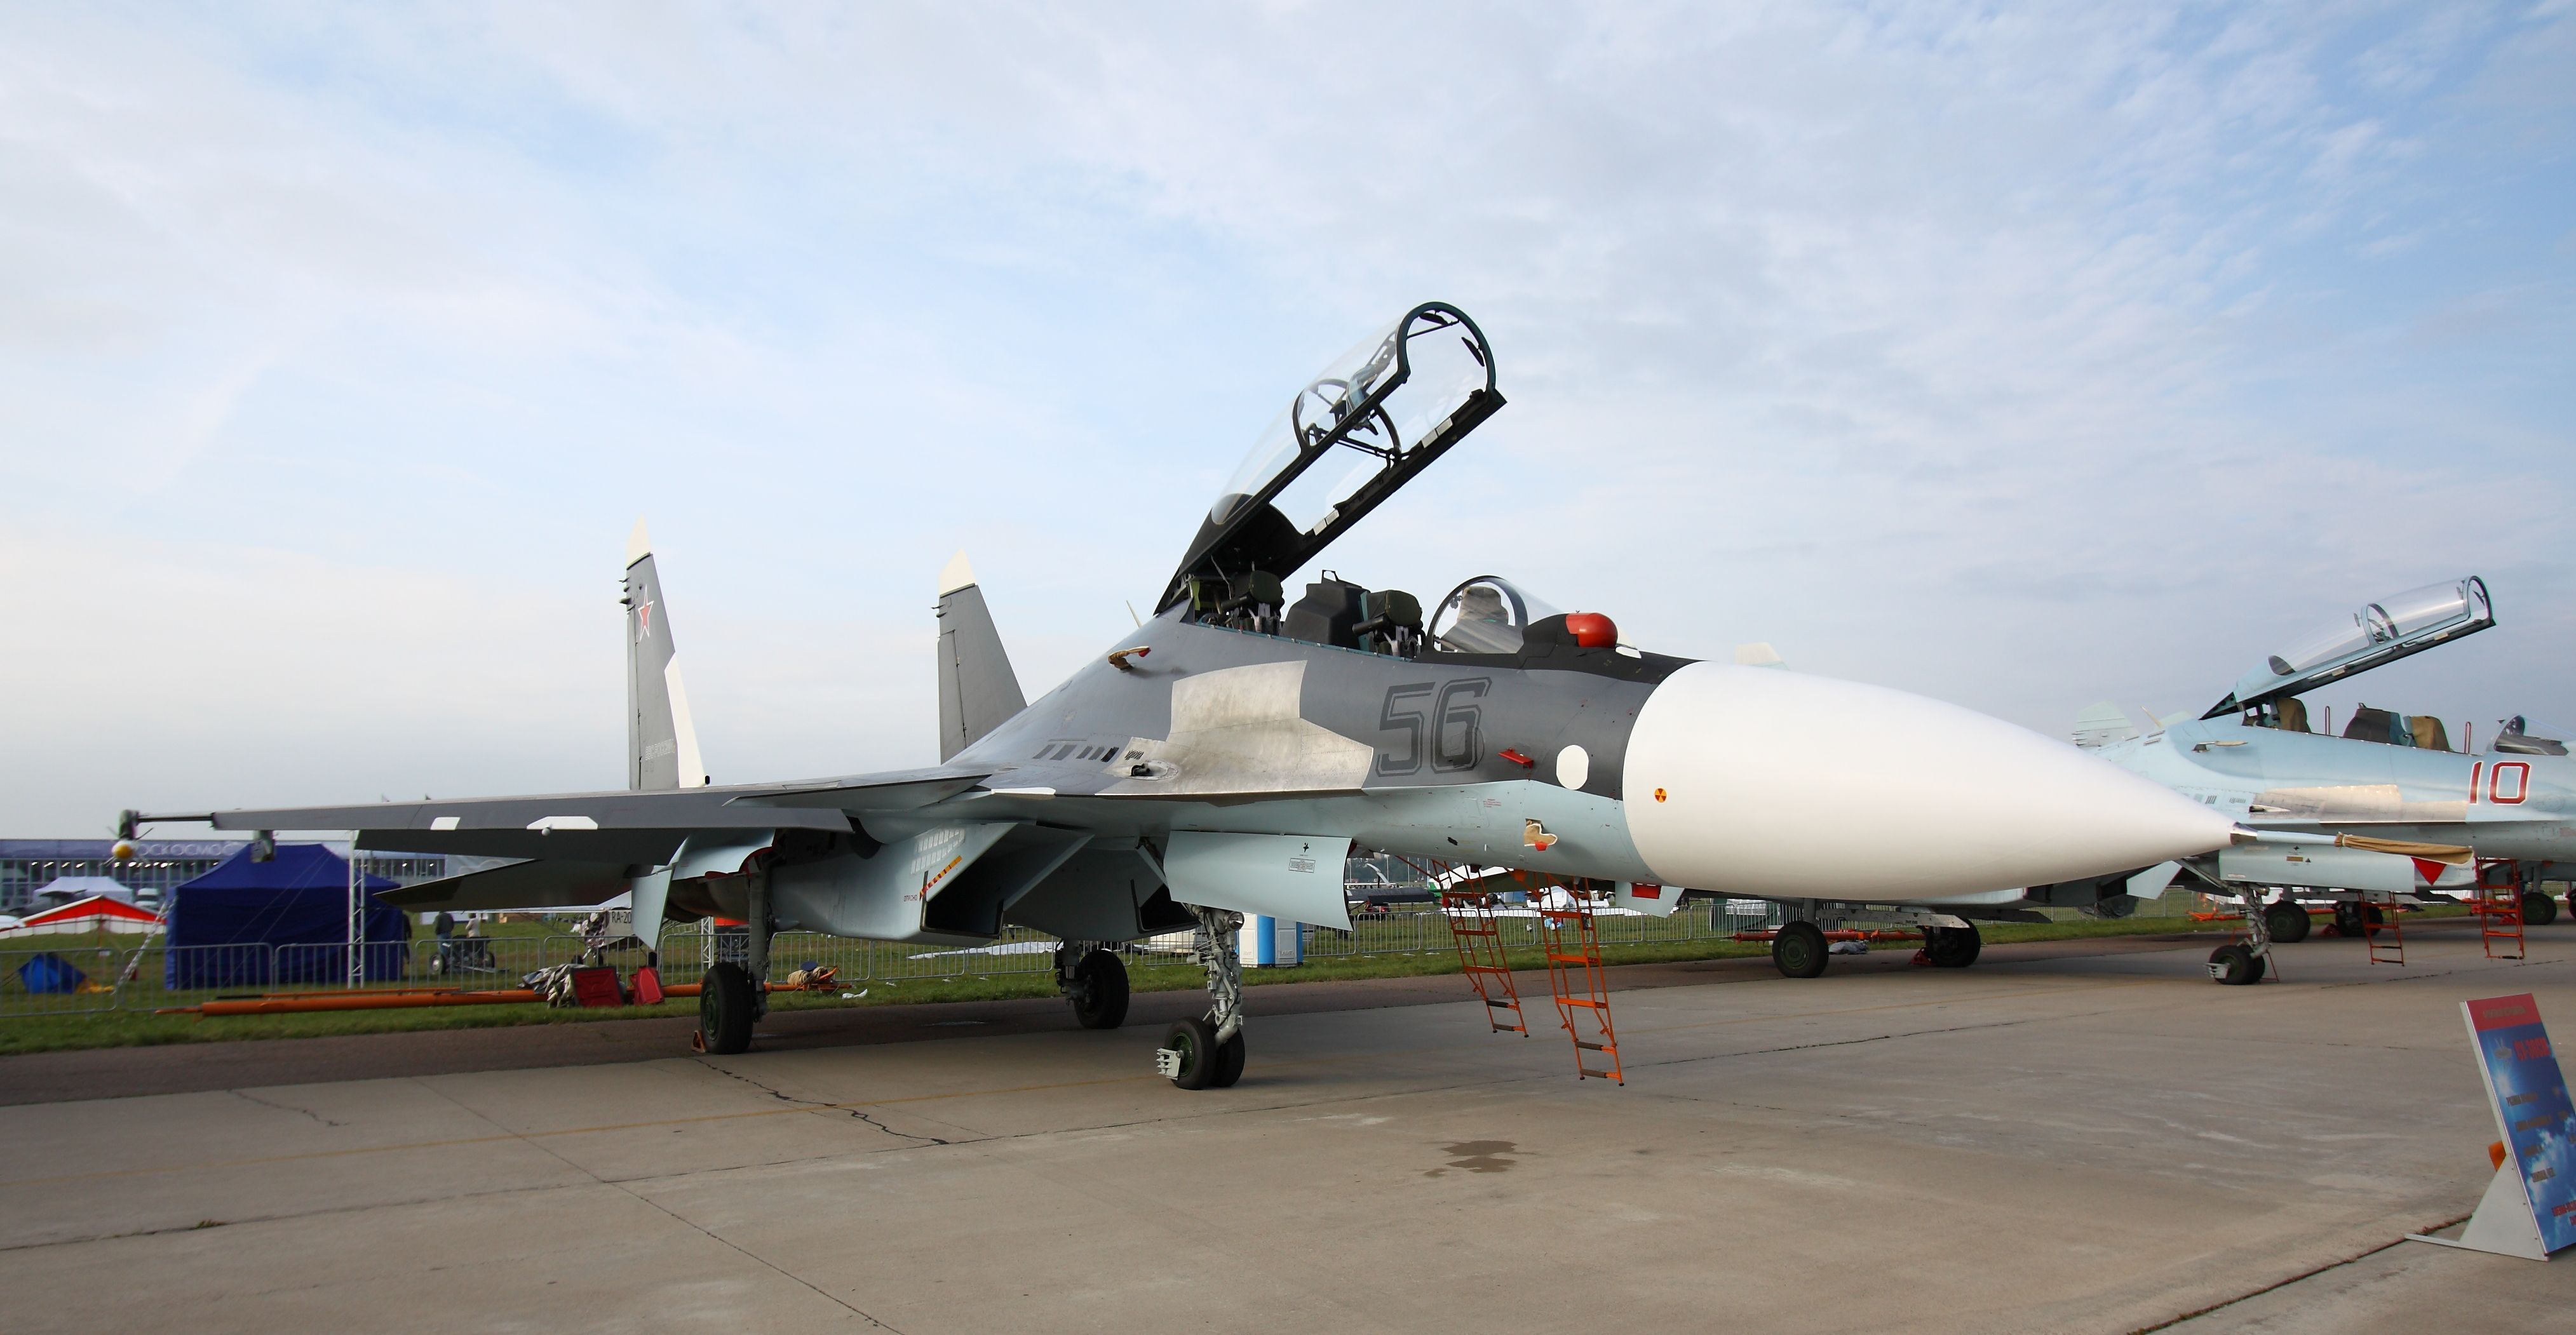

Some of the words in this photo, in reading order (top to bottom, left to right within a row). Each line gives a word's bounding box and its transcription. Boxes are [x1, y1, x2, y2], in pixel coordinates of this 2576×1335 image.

[1375, 677, 1492, 777] 56
[2469, 761, 2531, 805] 10
[136, 843, 245, 855] ОСКОСМОС
